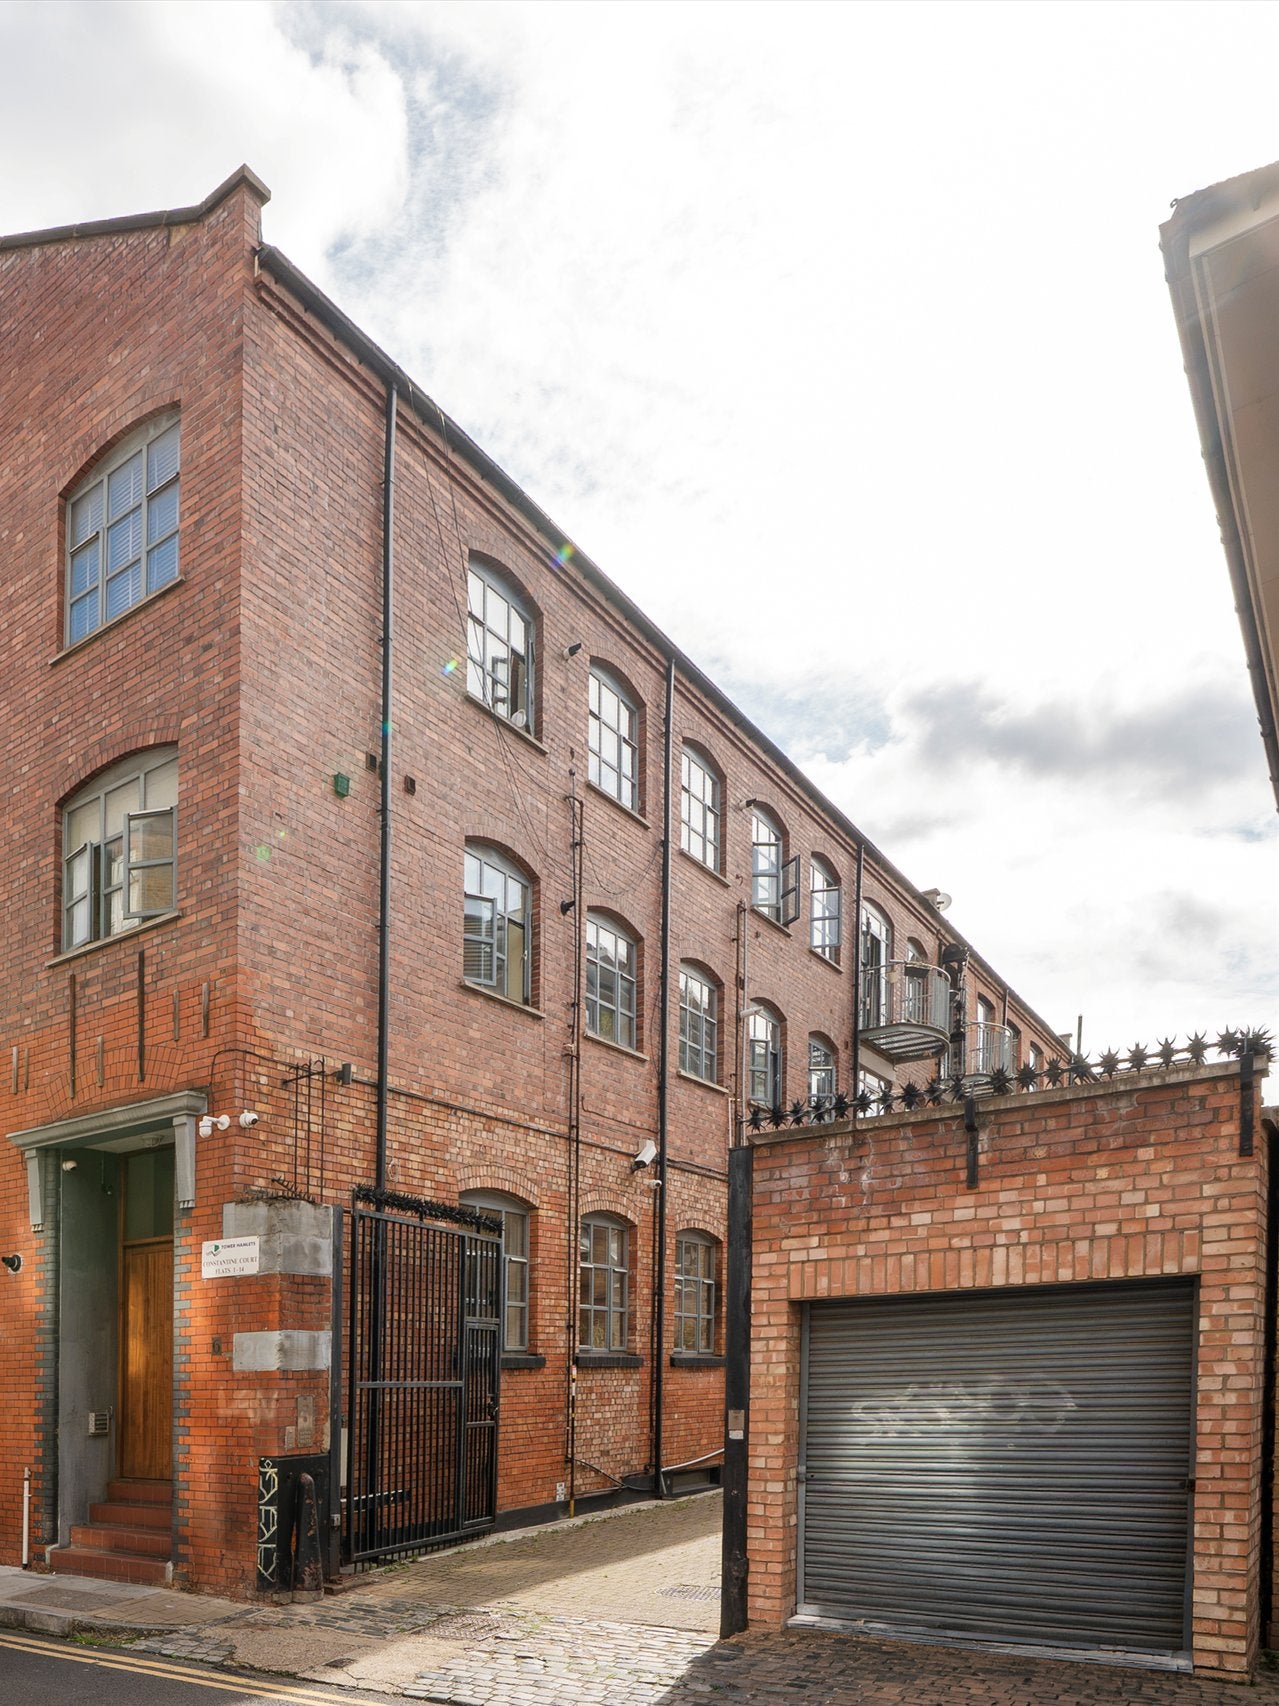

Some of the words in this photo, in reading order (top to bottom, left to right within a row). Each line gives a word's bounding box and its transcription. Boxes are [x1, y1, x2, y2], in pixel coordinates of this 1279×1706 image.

[202, 1258, 237, 1267] CONSTANTINE
[239, 1256, 258, 1264] COURT
[215, 1267, 231, 1275] FLATS
